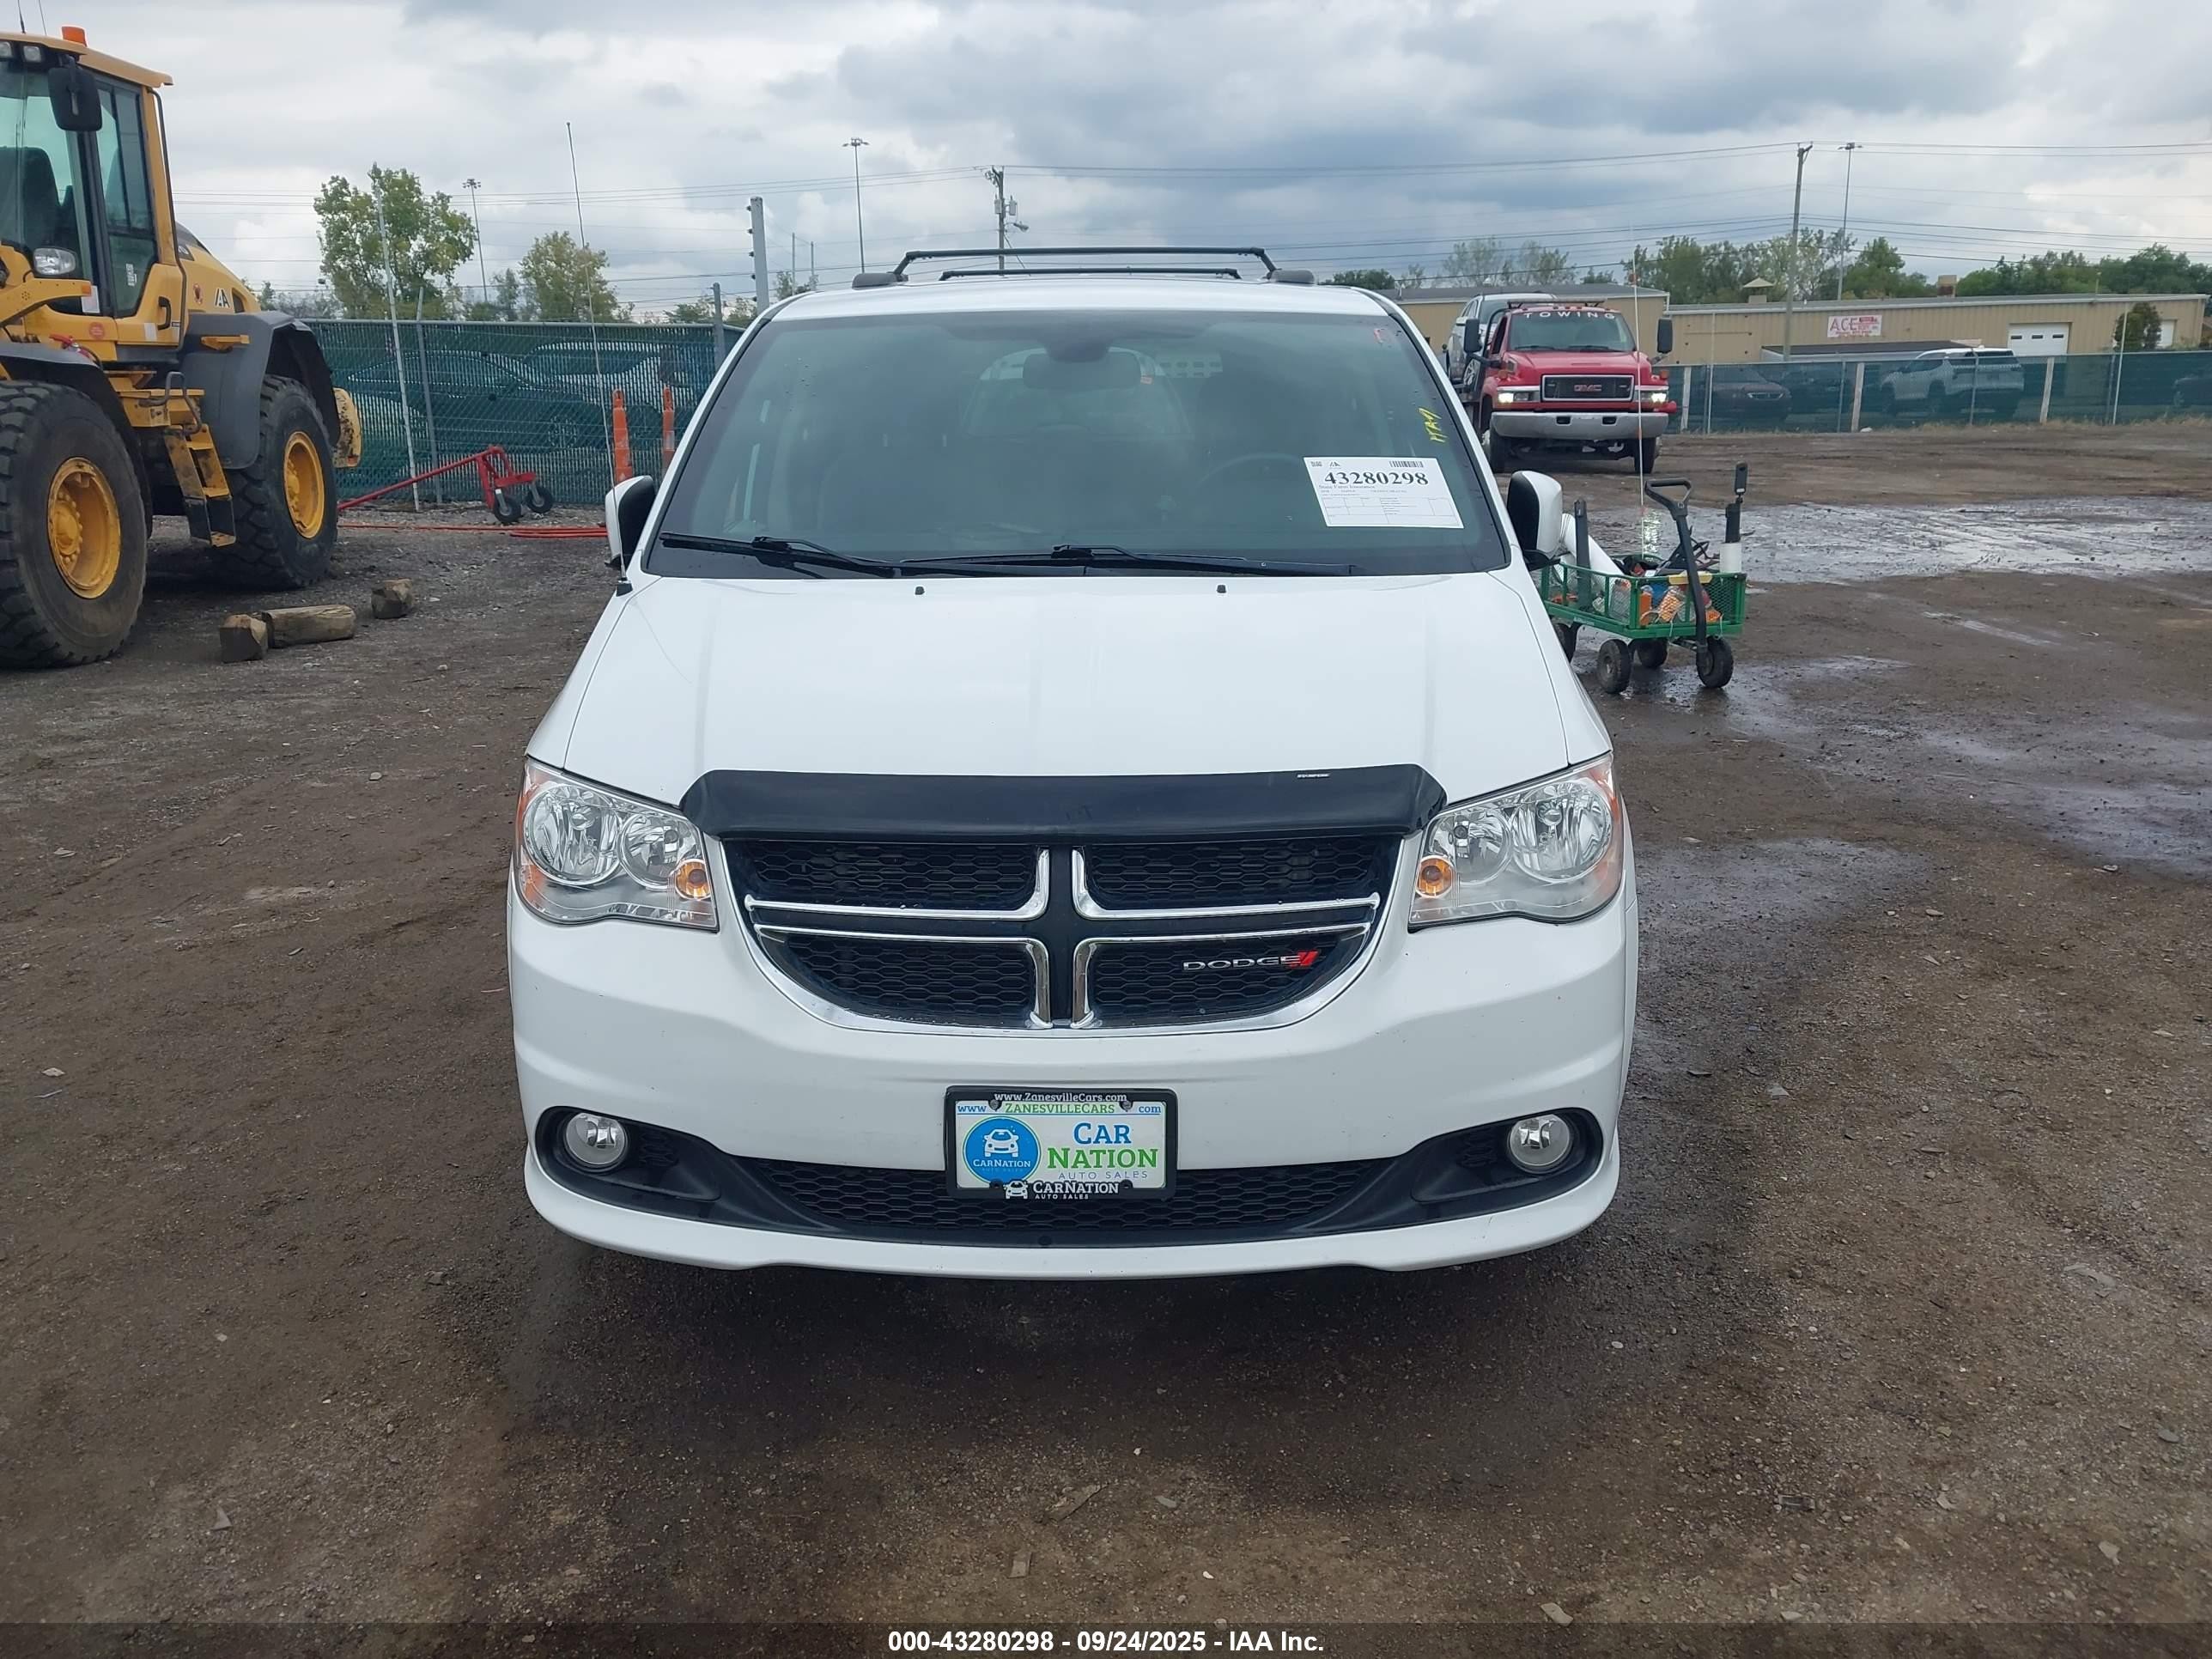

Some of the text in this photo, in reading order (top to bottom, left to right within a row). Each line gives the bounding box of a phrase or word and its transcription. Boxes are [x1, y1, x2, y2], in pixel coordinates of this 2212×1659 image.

[1523, 311, 1615, 319] TOWING
[1829, 317, 1858, 331] ACE
[1573, 384, 1602, 392] GMC
[1324, 471, 1429, 485] 43280298
[1182, 955, 1302, 970] DODGE
[994, 1092, 1127, 1103] www.ZanesvilleCars.com
[1073, 1122, 1132, 1145] CAR
[1047, 1147, 1158, 1169] NATION
[1058, 1170, 1148, 1180] AUTO SALES
